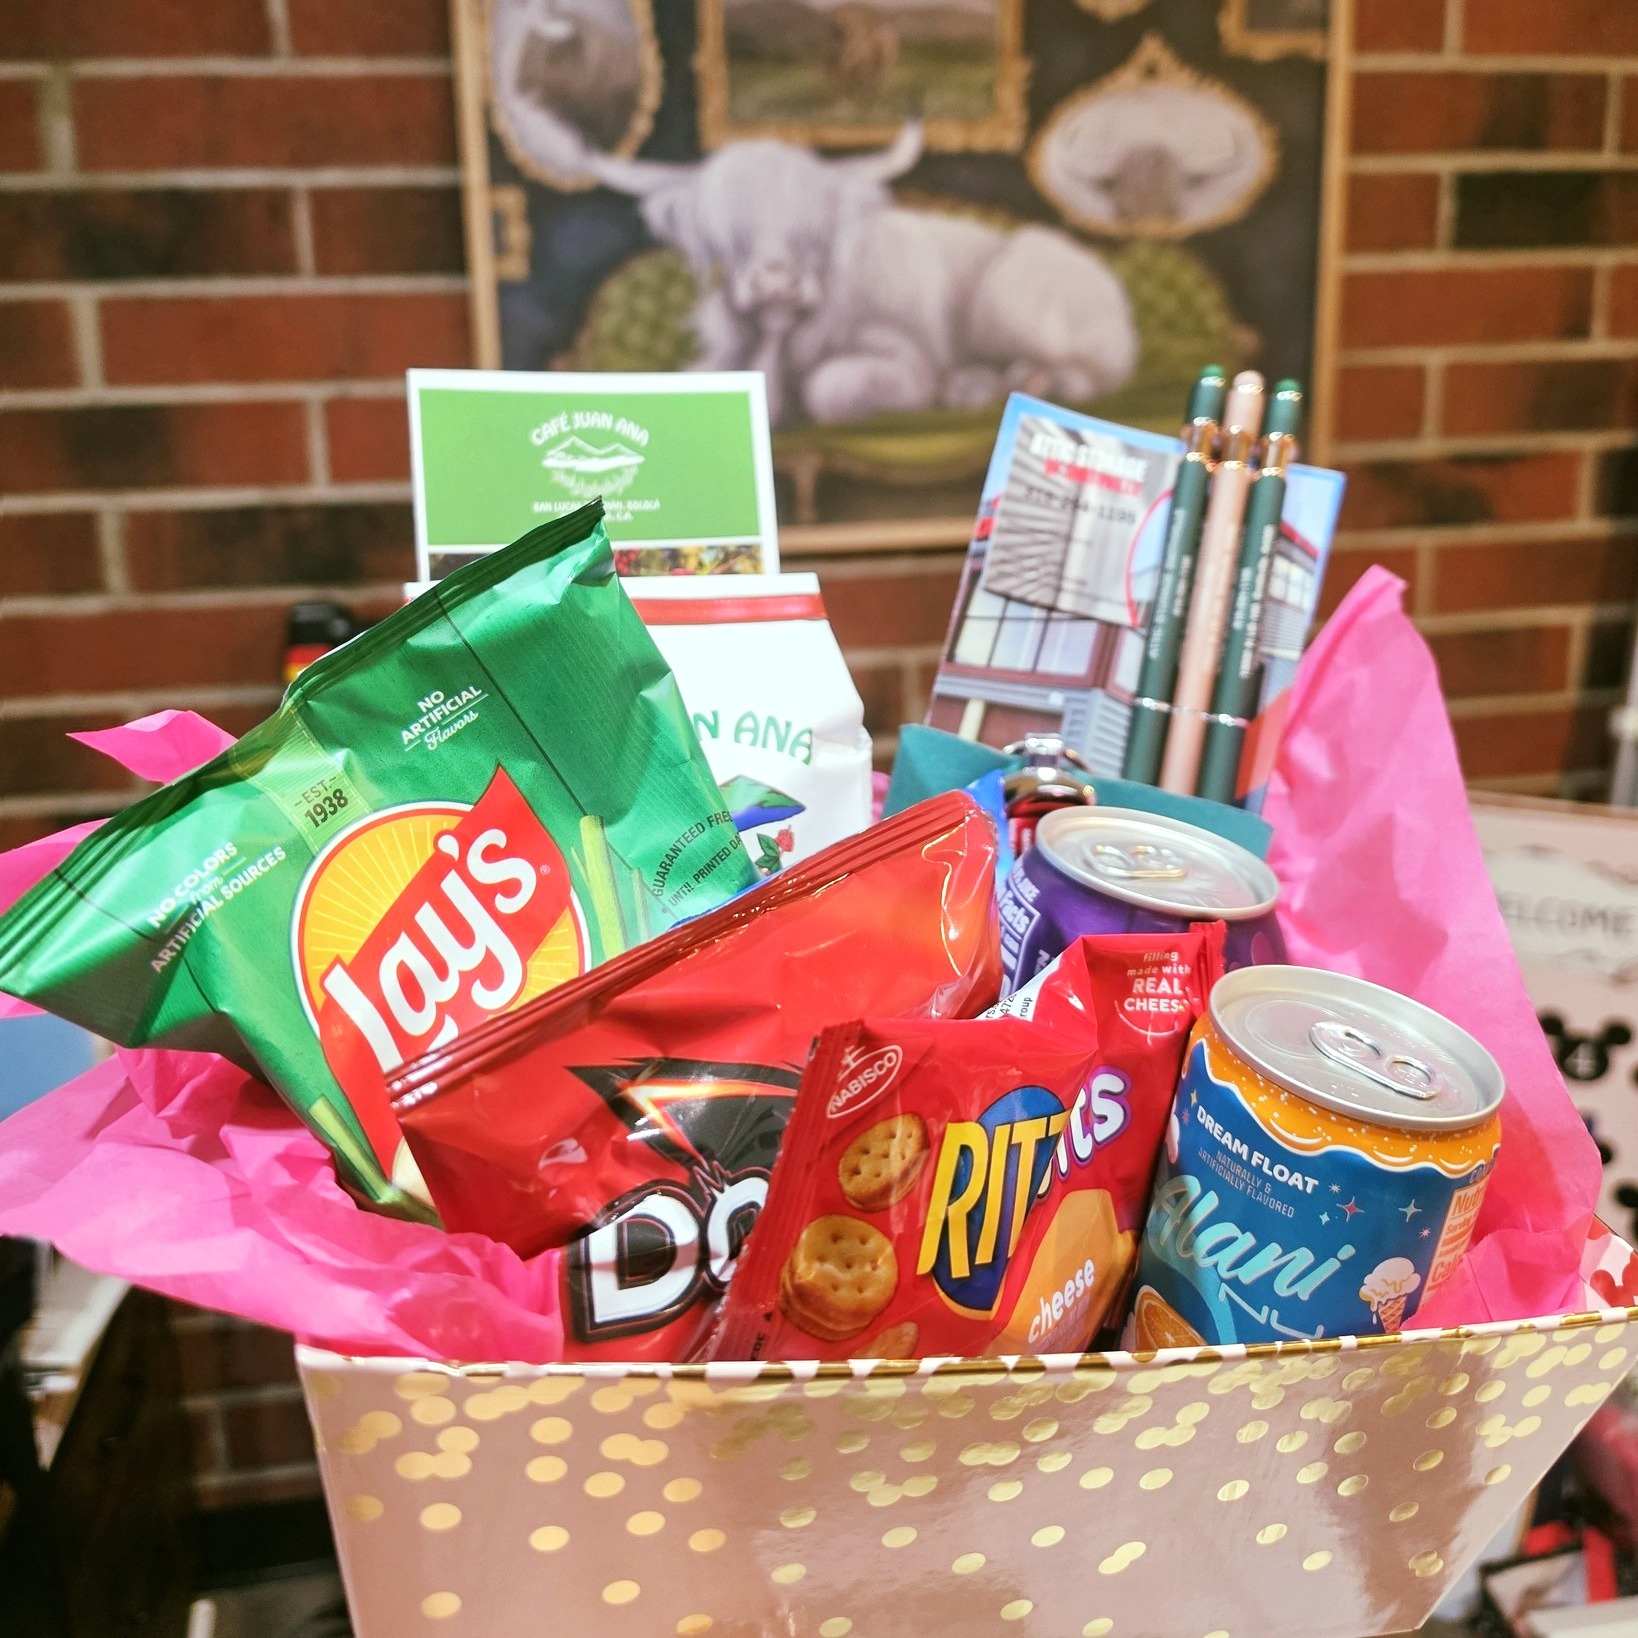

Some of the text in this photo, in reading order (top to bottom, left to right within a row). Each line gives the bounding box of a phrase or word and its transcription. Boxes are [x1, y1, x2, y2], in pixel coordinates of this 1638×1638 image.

[531, 411, 649, 446] CAFÉ JUAN ANA
[401, 686, 482, 744] ARTIFICIAL
[418, 690, 445, 713] NO
[424, 710, 479, 751] Flavors
[733, 710, 814, 766] ANA
[304, 788, 349, 828] 1938
[147, 842, 238, 928] NO COLORS
[652, 822, 706, 898] GUARANTEED
[668, 881, 694, 907] UNTIL
[692, 847, 731, 884] PRINTED
[151, 846, 287, 973] ARTIFICIAL SOURCES
[190, 876, 223, 905] from
[323, 829, 537, 1074] Lay's
[1126, 963, 1192, 977] made with
[1143, 951, 1179, 962] filling
[1123, 997, 1186, 1014] CHEES
[1132, 976, 1184, 995] REAL
[830, 1052, 897, 1112] NABISCO
[1197, 1105, 1319, 1195] DREAM FLOAT
[1216, 1150, 1272, 1194] NATURALLY &
[1198, 1147, 1295, 1218] ARTIFICIALLY FLAVORED
[1154, 1175, 1356, 1302] Alani
[1028, 1259, 1095, 1344] cheese
